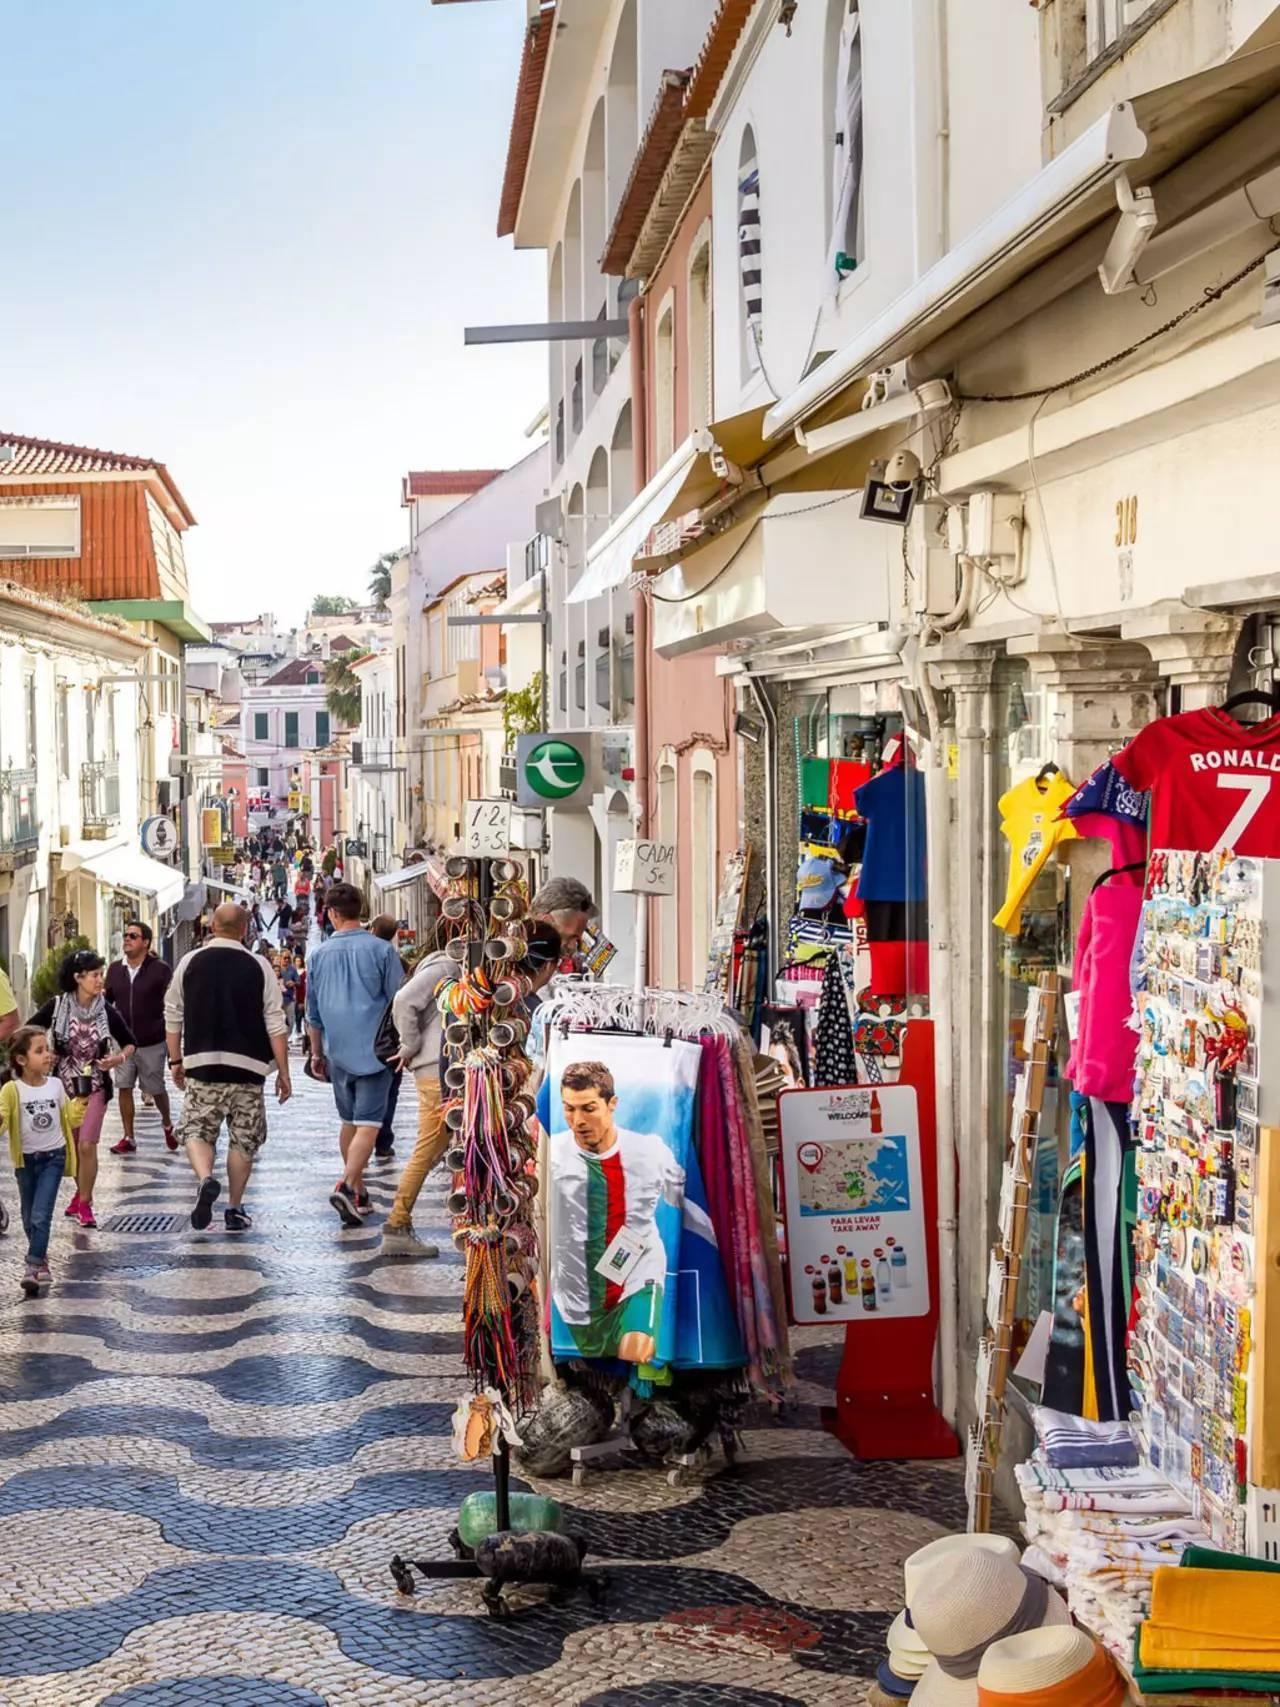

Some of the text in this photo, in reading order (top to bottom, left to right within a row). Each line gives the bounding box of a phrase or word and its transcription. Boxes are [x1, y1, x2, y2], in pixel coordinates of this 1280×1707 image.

[1209, 773, 1271, 853] 7
[470, 832, 480, 850] 3
[637, 843, 674, 865] CADA
[830, 1216, 880, 1225] PARA LEVAR
[832, 1224, 880, 1233] TAKE AWAY
